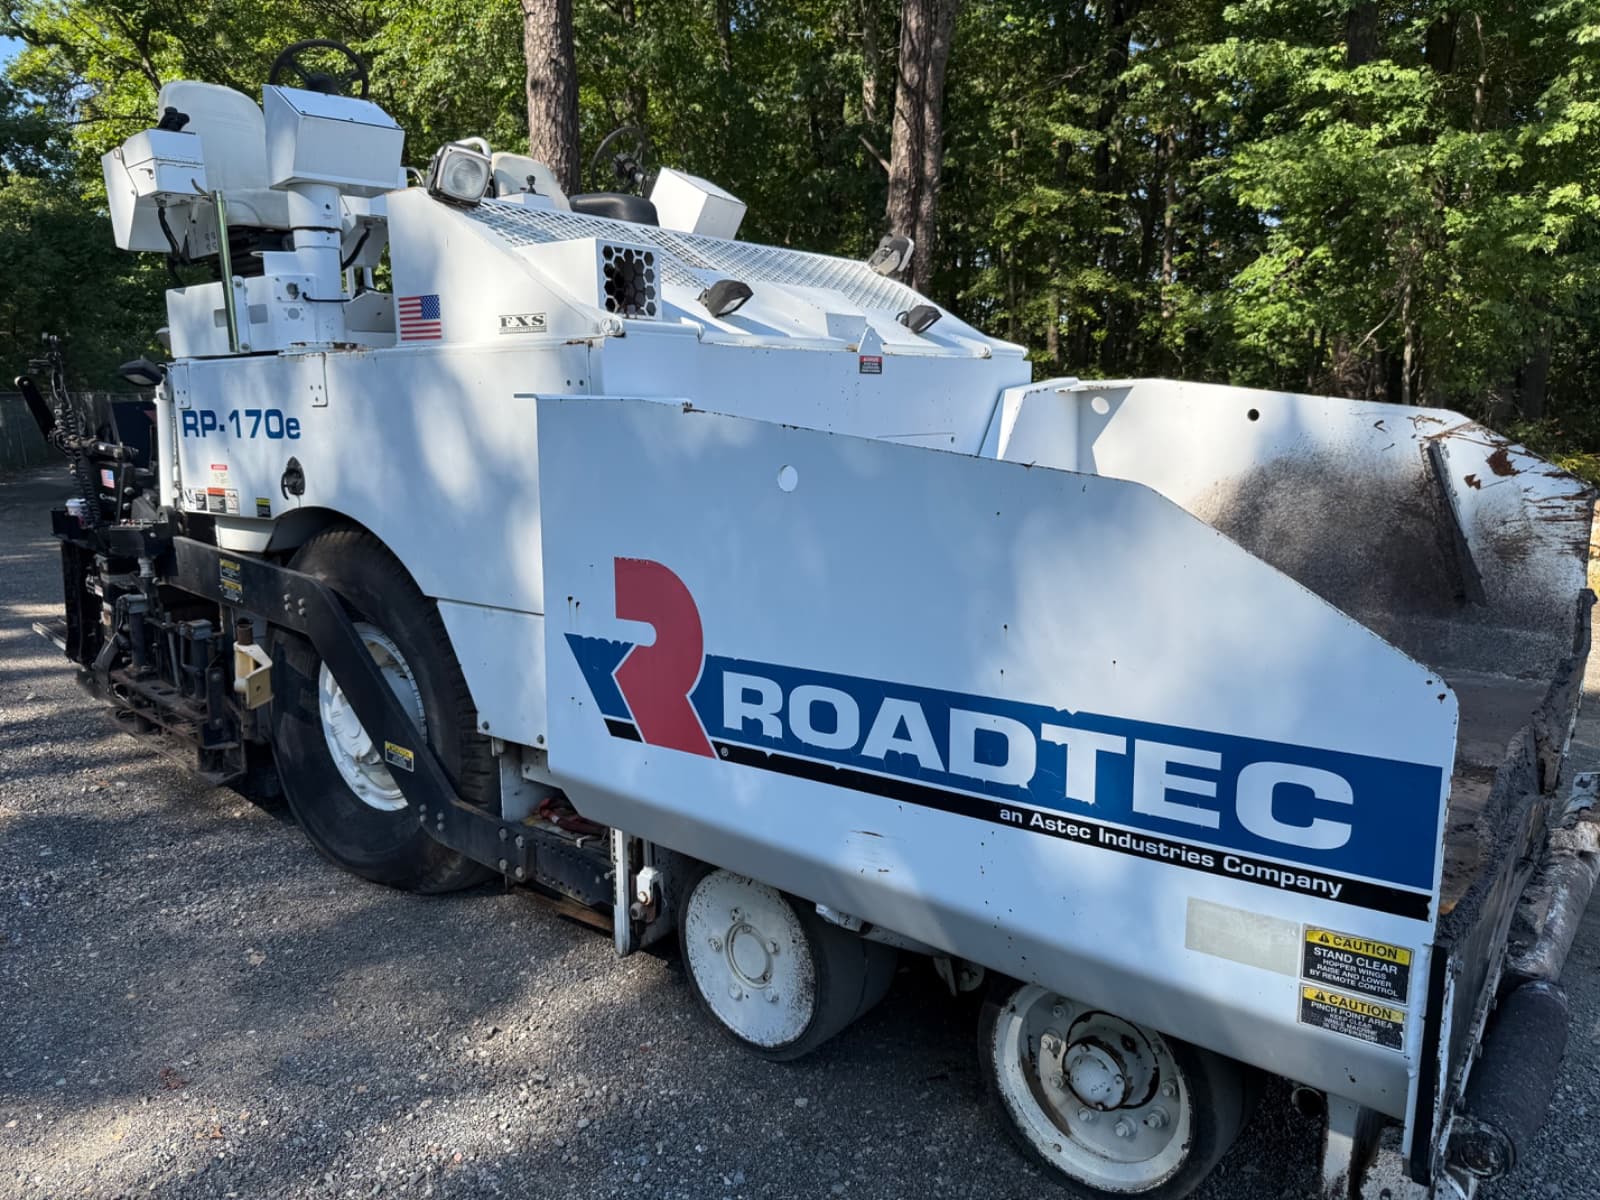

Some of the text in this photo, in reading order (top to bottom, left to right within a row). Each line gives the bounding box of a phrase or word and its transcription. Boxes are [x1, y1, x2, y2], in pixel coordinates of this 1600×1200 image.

[501, 315, 544, 327] FXS
[182, 408, 301, 439] RP-170e
[722, 670, 1354, 850] ROADTEC
[999, 807, 1343, 898] an Astec Industries Company
[1333, 936, 1397, 959] CAUTION
[1313, 947, 1398, 975] STAND CLEAR
[1322, 959, 1387, 980] HOPPER WINGS
[1309, 968, 1399, 997] BY REMOTE CONTROL
[1317, 963, 1392, 988] RAISE AND LOWER
[1311, 1001, 1393, 1029] PINCH POINT AREA
[1329, 995, 1391, 1019] CAUTION
[1329, 1013, 1347, 1023] KEEP
